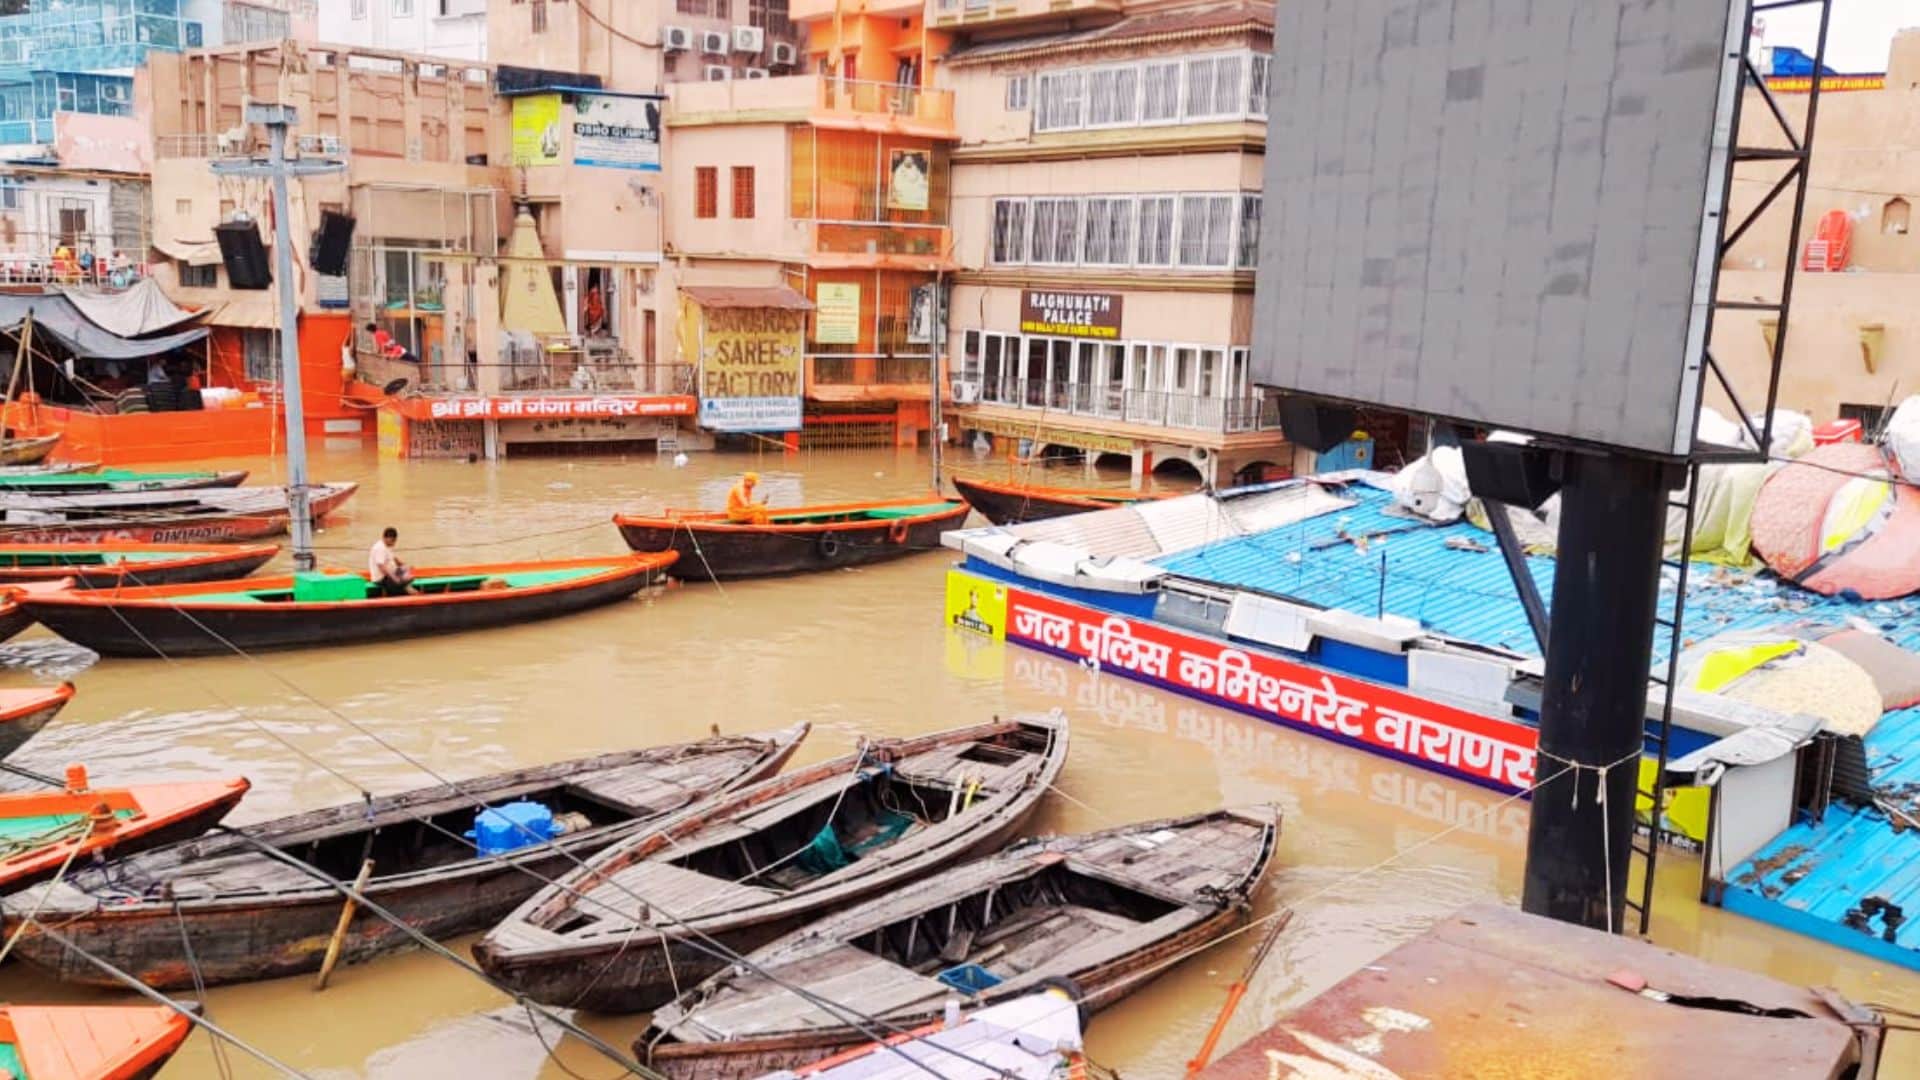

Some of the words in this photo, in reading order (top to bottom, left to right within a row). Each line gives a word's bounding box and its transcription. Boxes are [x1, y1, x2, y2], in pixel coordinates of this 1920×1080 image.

[1030, 292, 1110, 312] RAGHUNATH
[1044, 309, 1093, 325] PALACE
[718, 340, 781, 365] SAREE
[706, 371, 797, 398] FACTORY
[1014, 604, 1072, 650] जल
[1078, 616, 1172, 678] पुलिस
[1179, 649, 1369, 737] कमिश्नरेट
[1375, 706, 1537, 790] वाराणस
